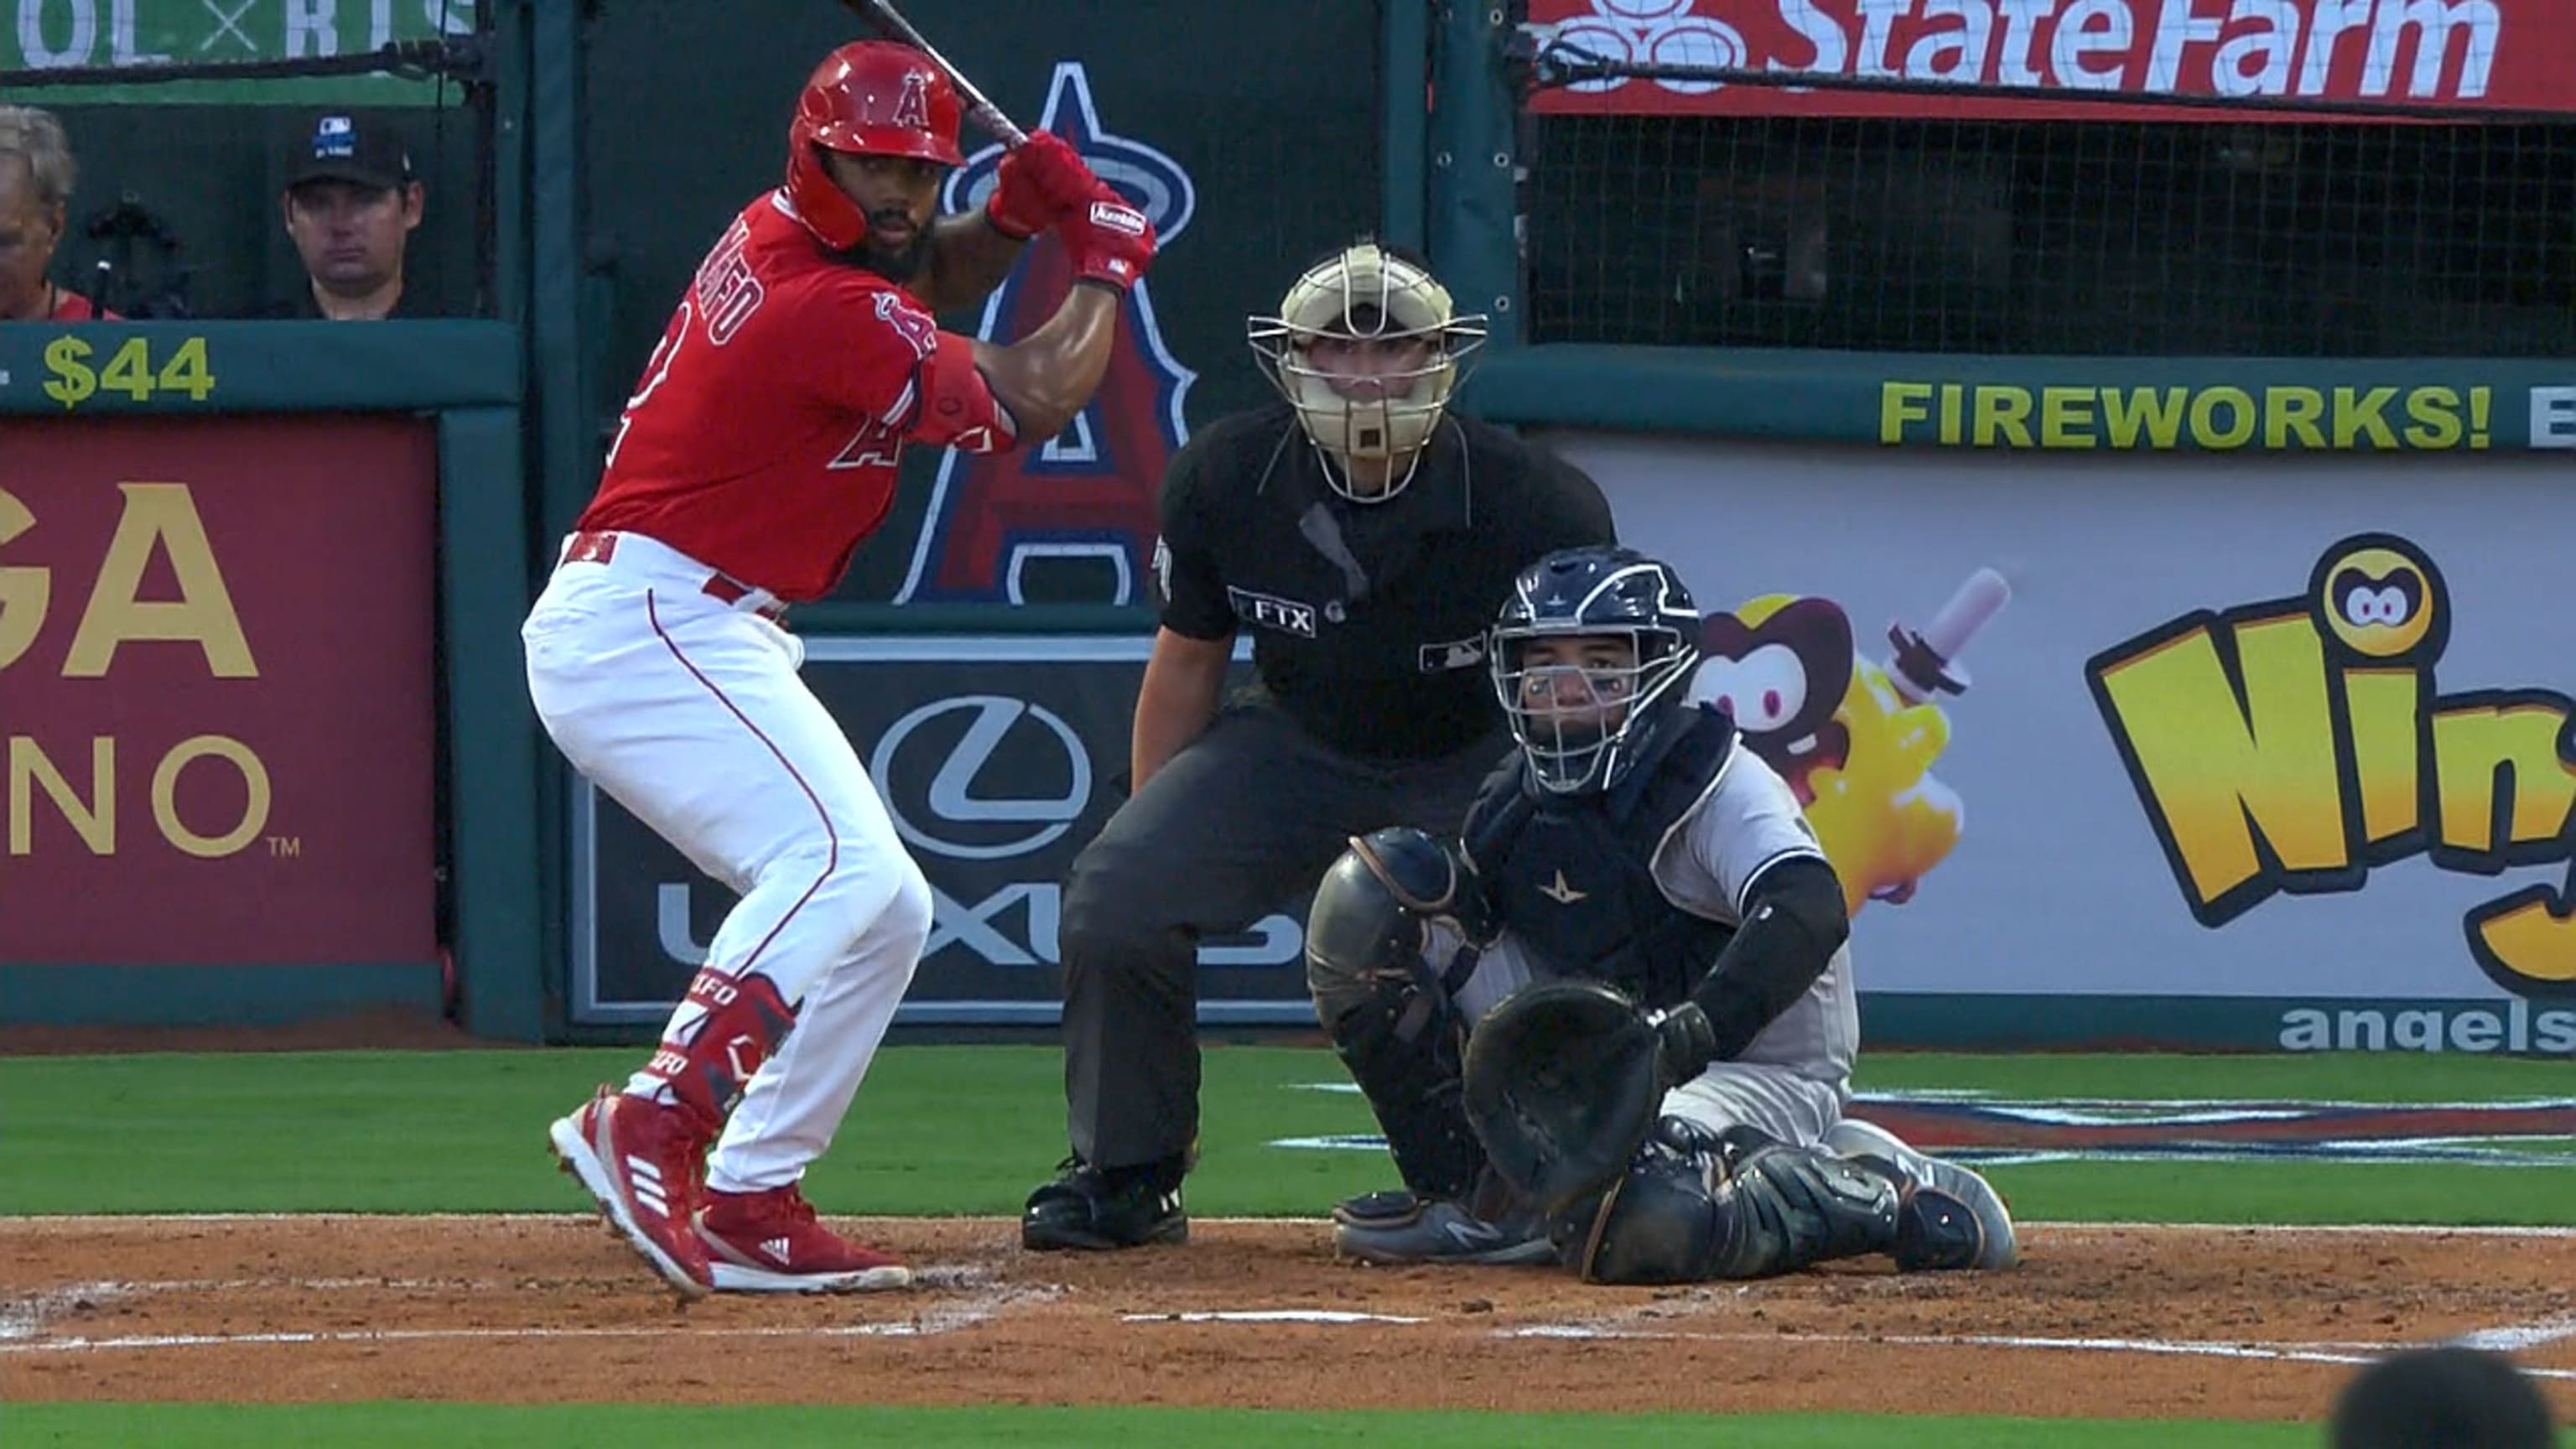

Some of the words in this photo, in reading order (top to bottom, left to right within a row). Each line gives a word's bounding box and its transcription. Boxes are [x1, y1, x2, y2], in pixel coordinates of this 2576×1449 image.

[43, 334, 216, 409] $44
[1880, 382, 2491, 449] FIREWORKS!
[1254, 600, 1311, 631] FTX
[9, 734, 272, 858] NO
